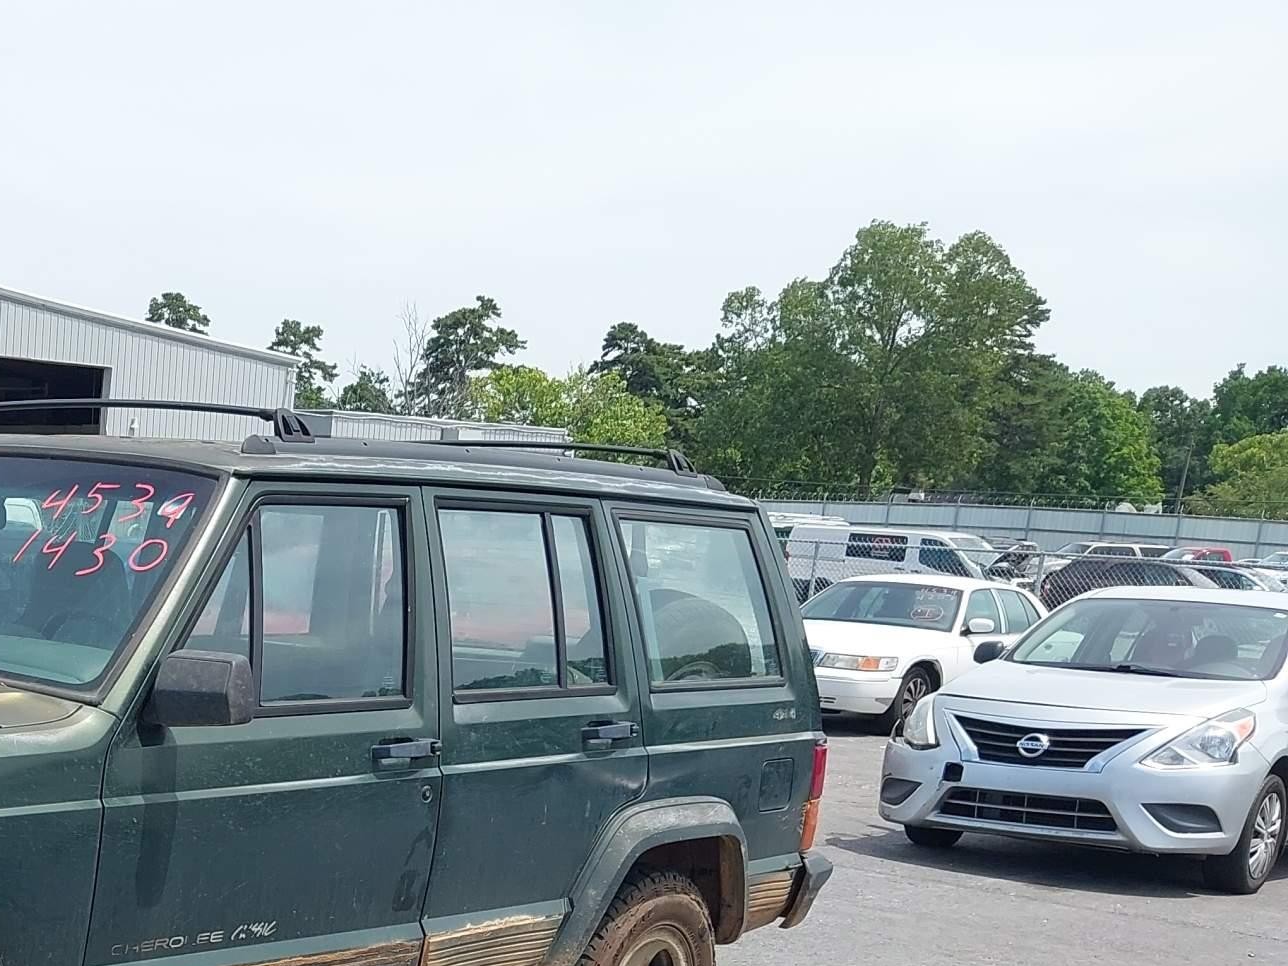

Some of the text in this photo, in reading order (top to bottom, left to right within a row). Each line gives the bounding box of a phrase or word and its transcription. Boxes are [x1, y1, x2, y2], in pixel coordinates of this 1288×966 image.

[41, 482, 196, 529] 4539
[12, 528, 168, 576] 1430
[1019, 741, 1045, 749] NISSAN
